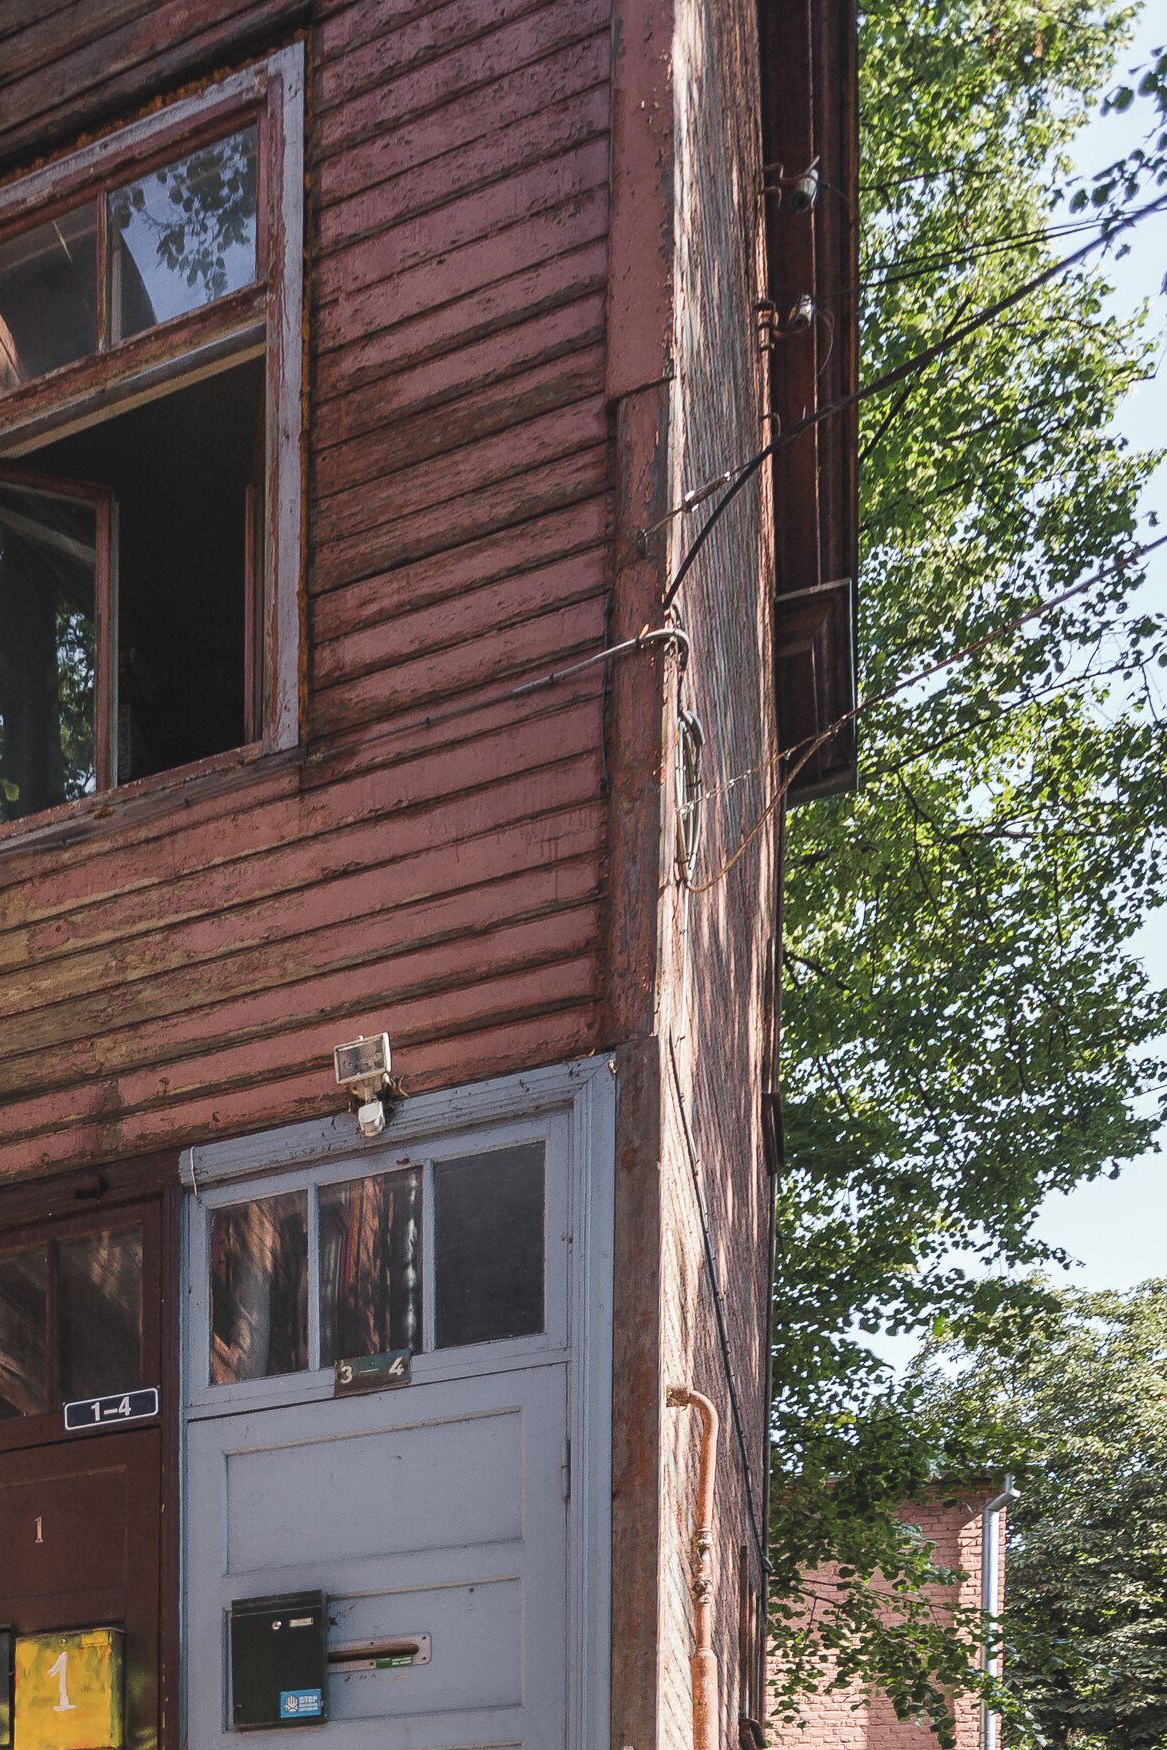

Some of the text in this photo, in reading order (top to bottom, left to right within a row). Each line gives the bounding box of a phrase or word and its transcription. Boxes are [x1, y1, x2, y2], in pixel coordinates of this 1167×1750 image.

[90, 1395, 132, 1421] 1-4
[34, 1515, 44, 1543] 1
[46, 1651, 77, 1712] 1
[299, 1695, 318, 1704] STOP
